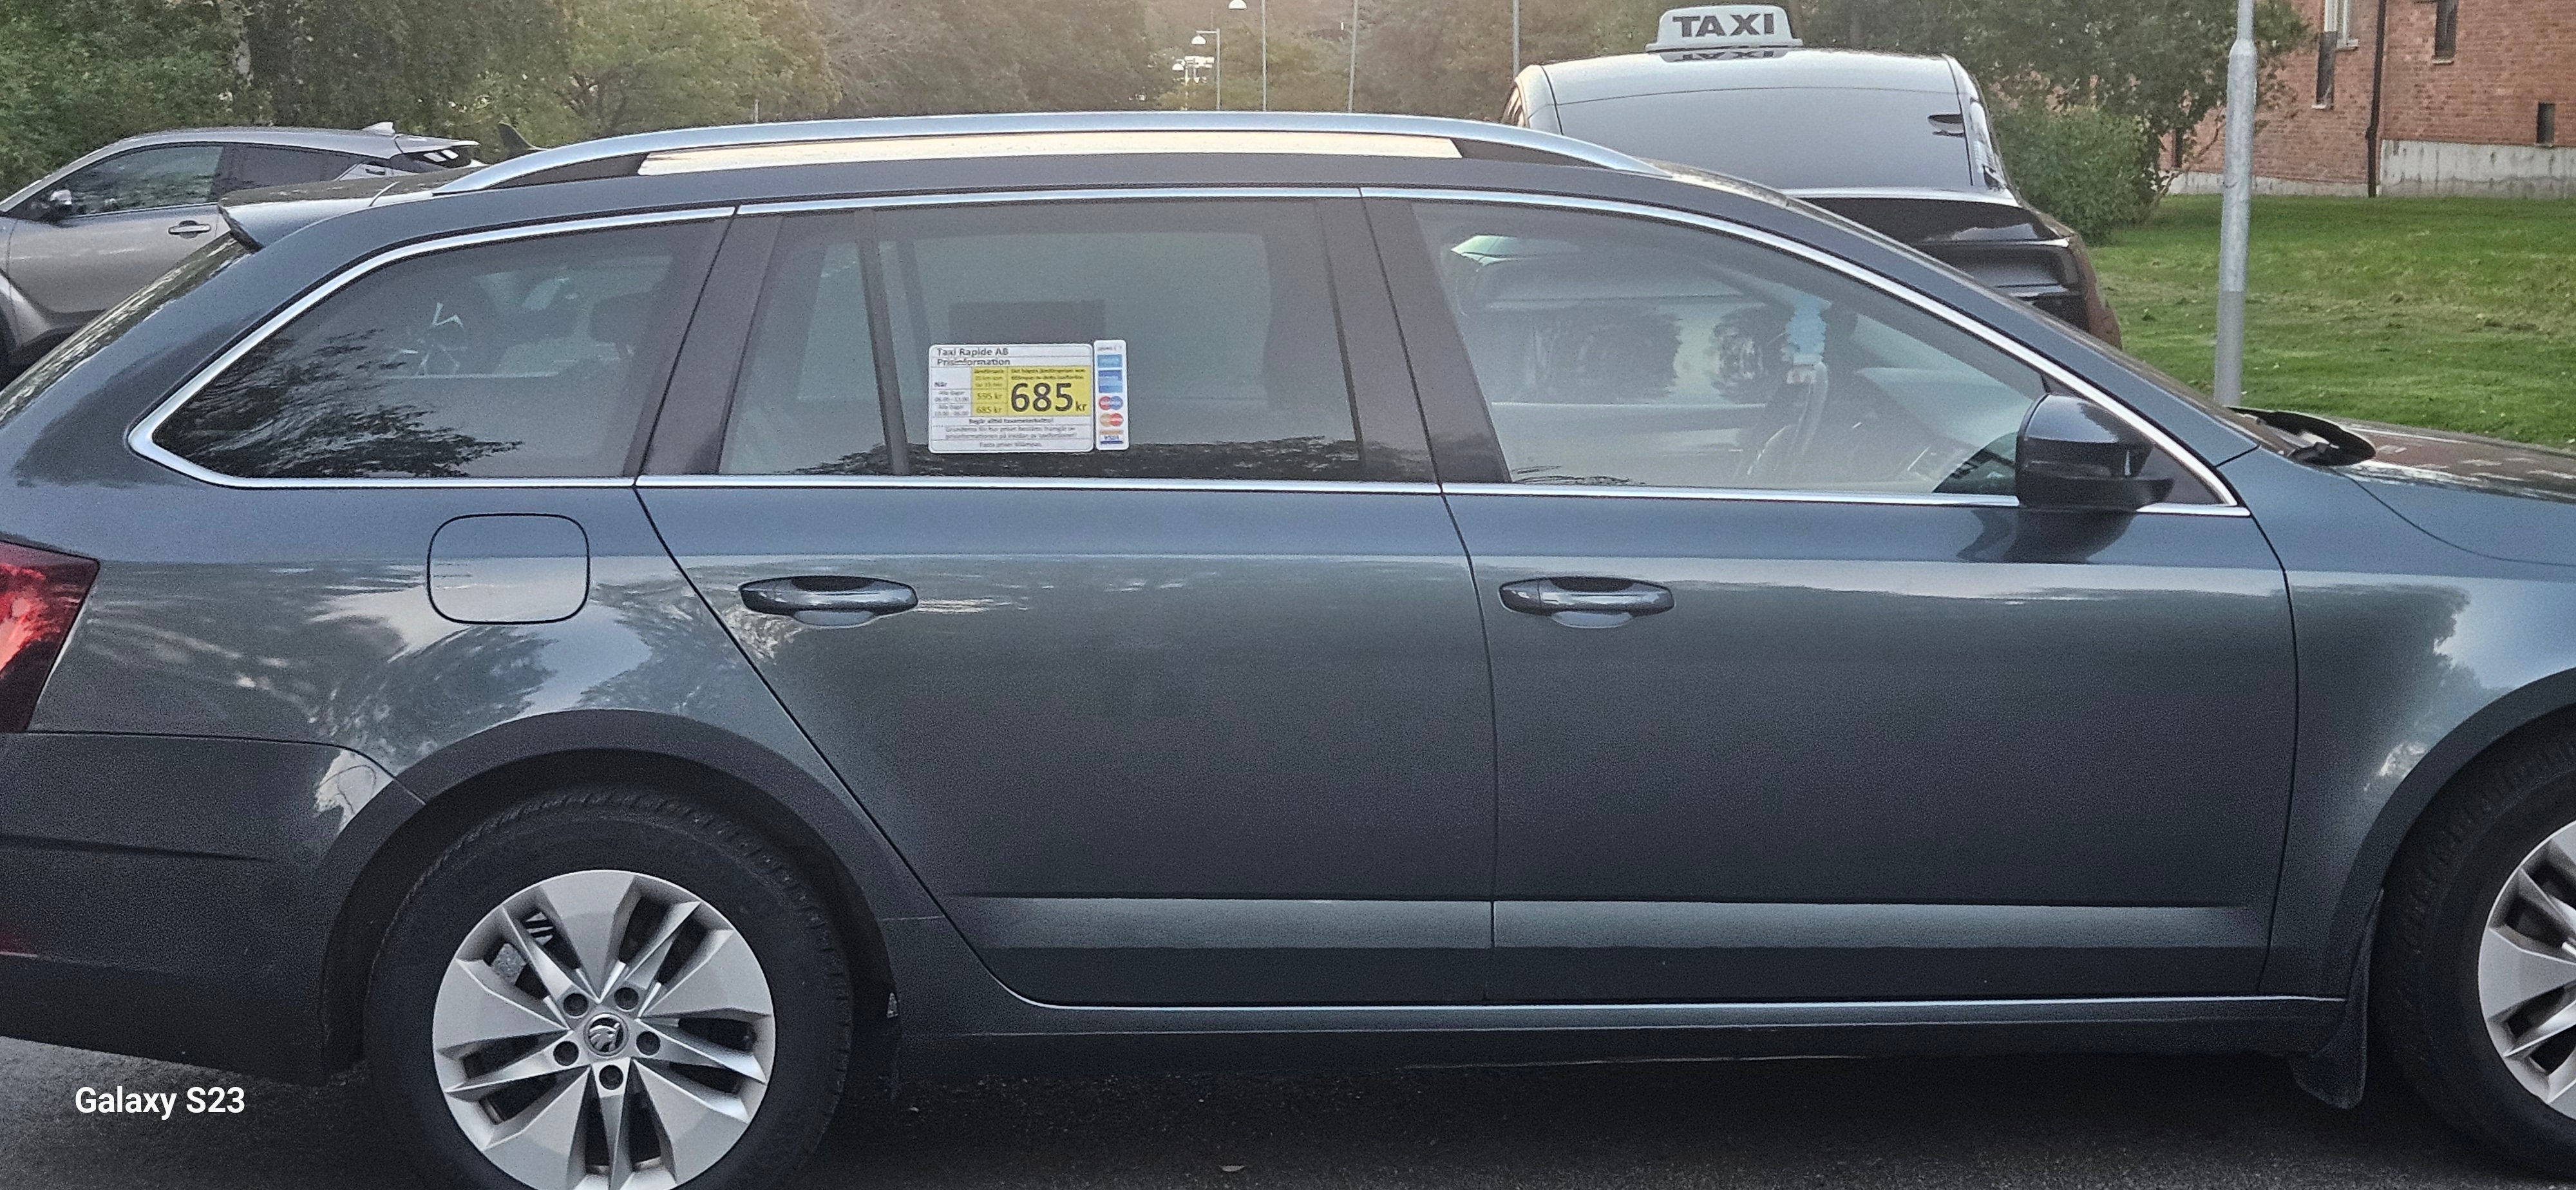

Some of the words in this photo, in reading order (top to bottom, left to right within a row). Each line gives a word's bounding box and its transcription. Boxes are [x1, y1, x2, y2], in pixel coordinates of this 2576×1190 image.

[1672, 13, 1774, 37] TAXI
[937, 348, 956, 356] Taxi
[959, 348, 992, 357] Rapide
[1011, 382, 1073, 412] 685
[1075, 401, 1087, 411] kr
